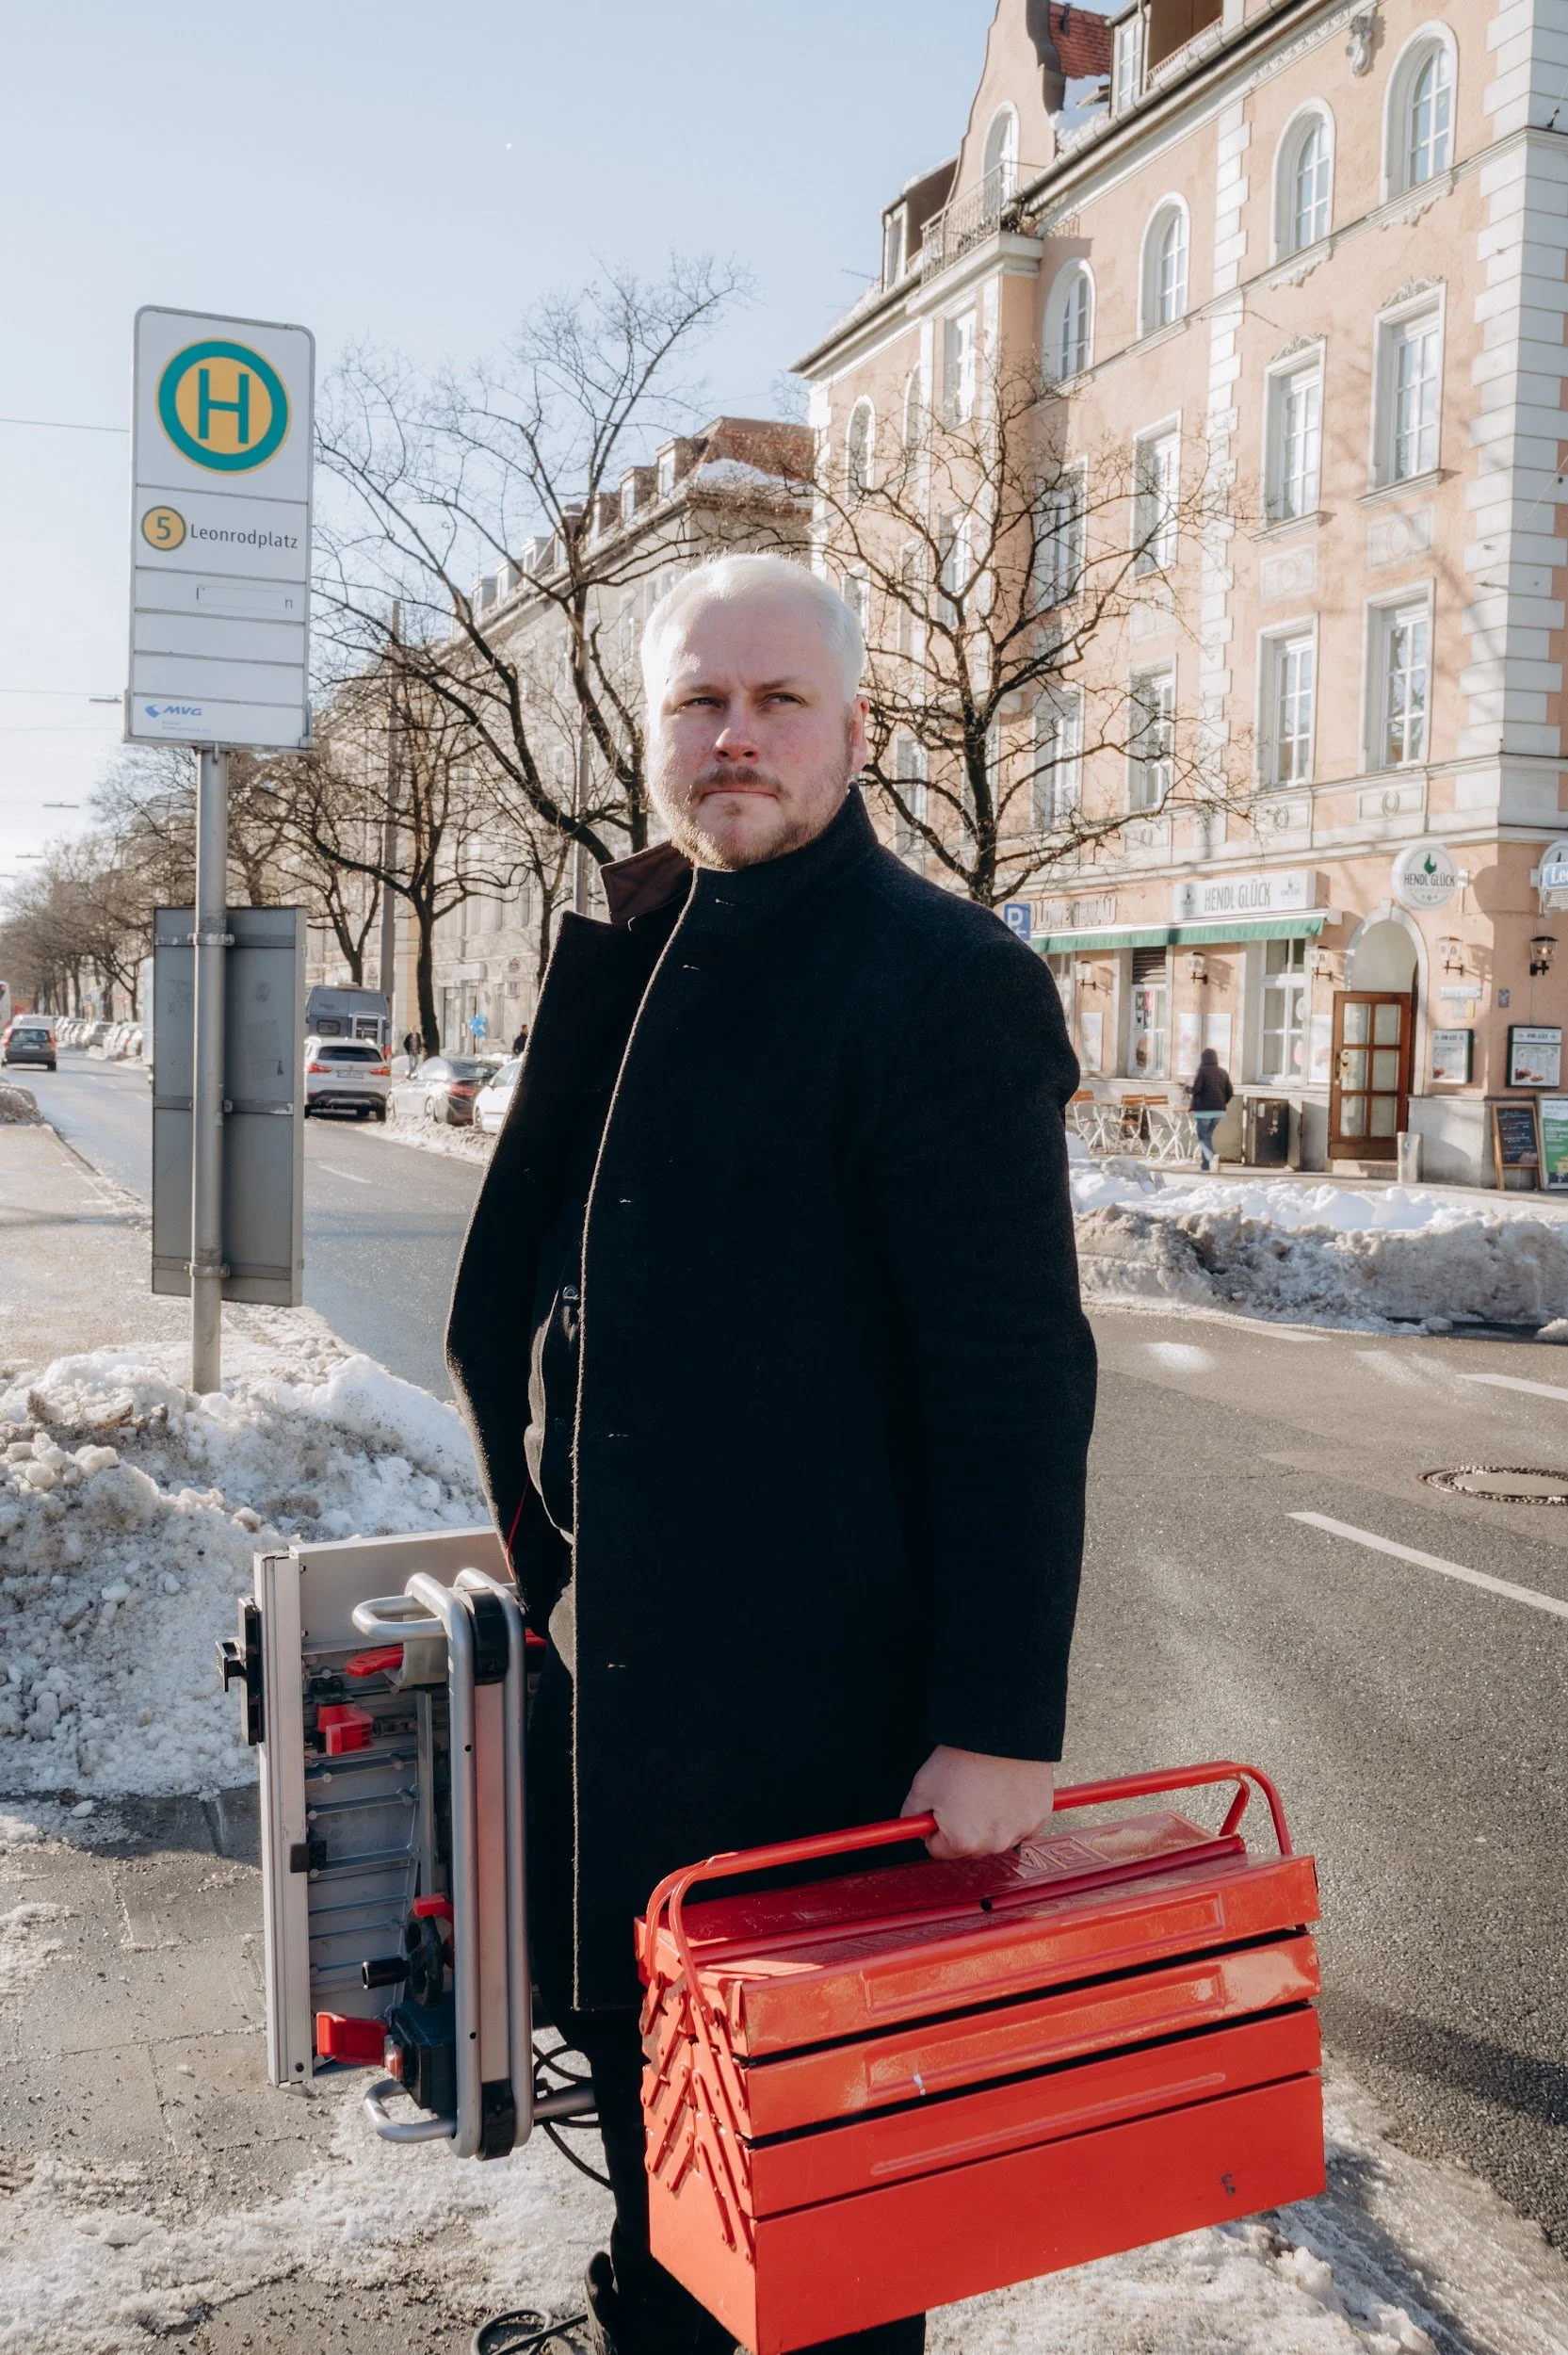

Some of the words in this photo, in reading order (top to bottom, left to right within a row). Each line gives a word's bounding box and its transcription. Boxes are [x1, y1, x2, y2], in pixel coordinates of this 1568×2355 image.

[198, 367, 250, 445] H
[156, 515, 171, 541] 5
[190, 524, 298, 548] Leonrodplatz
[162, 705, 202, 717] MVG
[1403, 872, 1429, 886] HENDL
[1431, 871, 1455, 886] GLÜCK
[1550, 866, 1568, 884] Le
[1204, 885, 1235, 912] HENDL
[1237, 878, 1271, 909] GLÜCK
[1008, 907, 1024, 929] P
